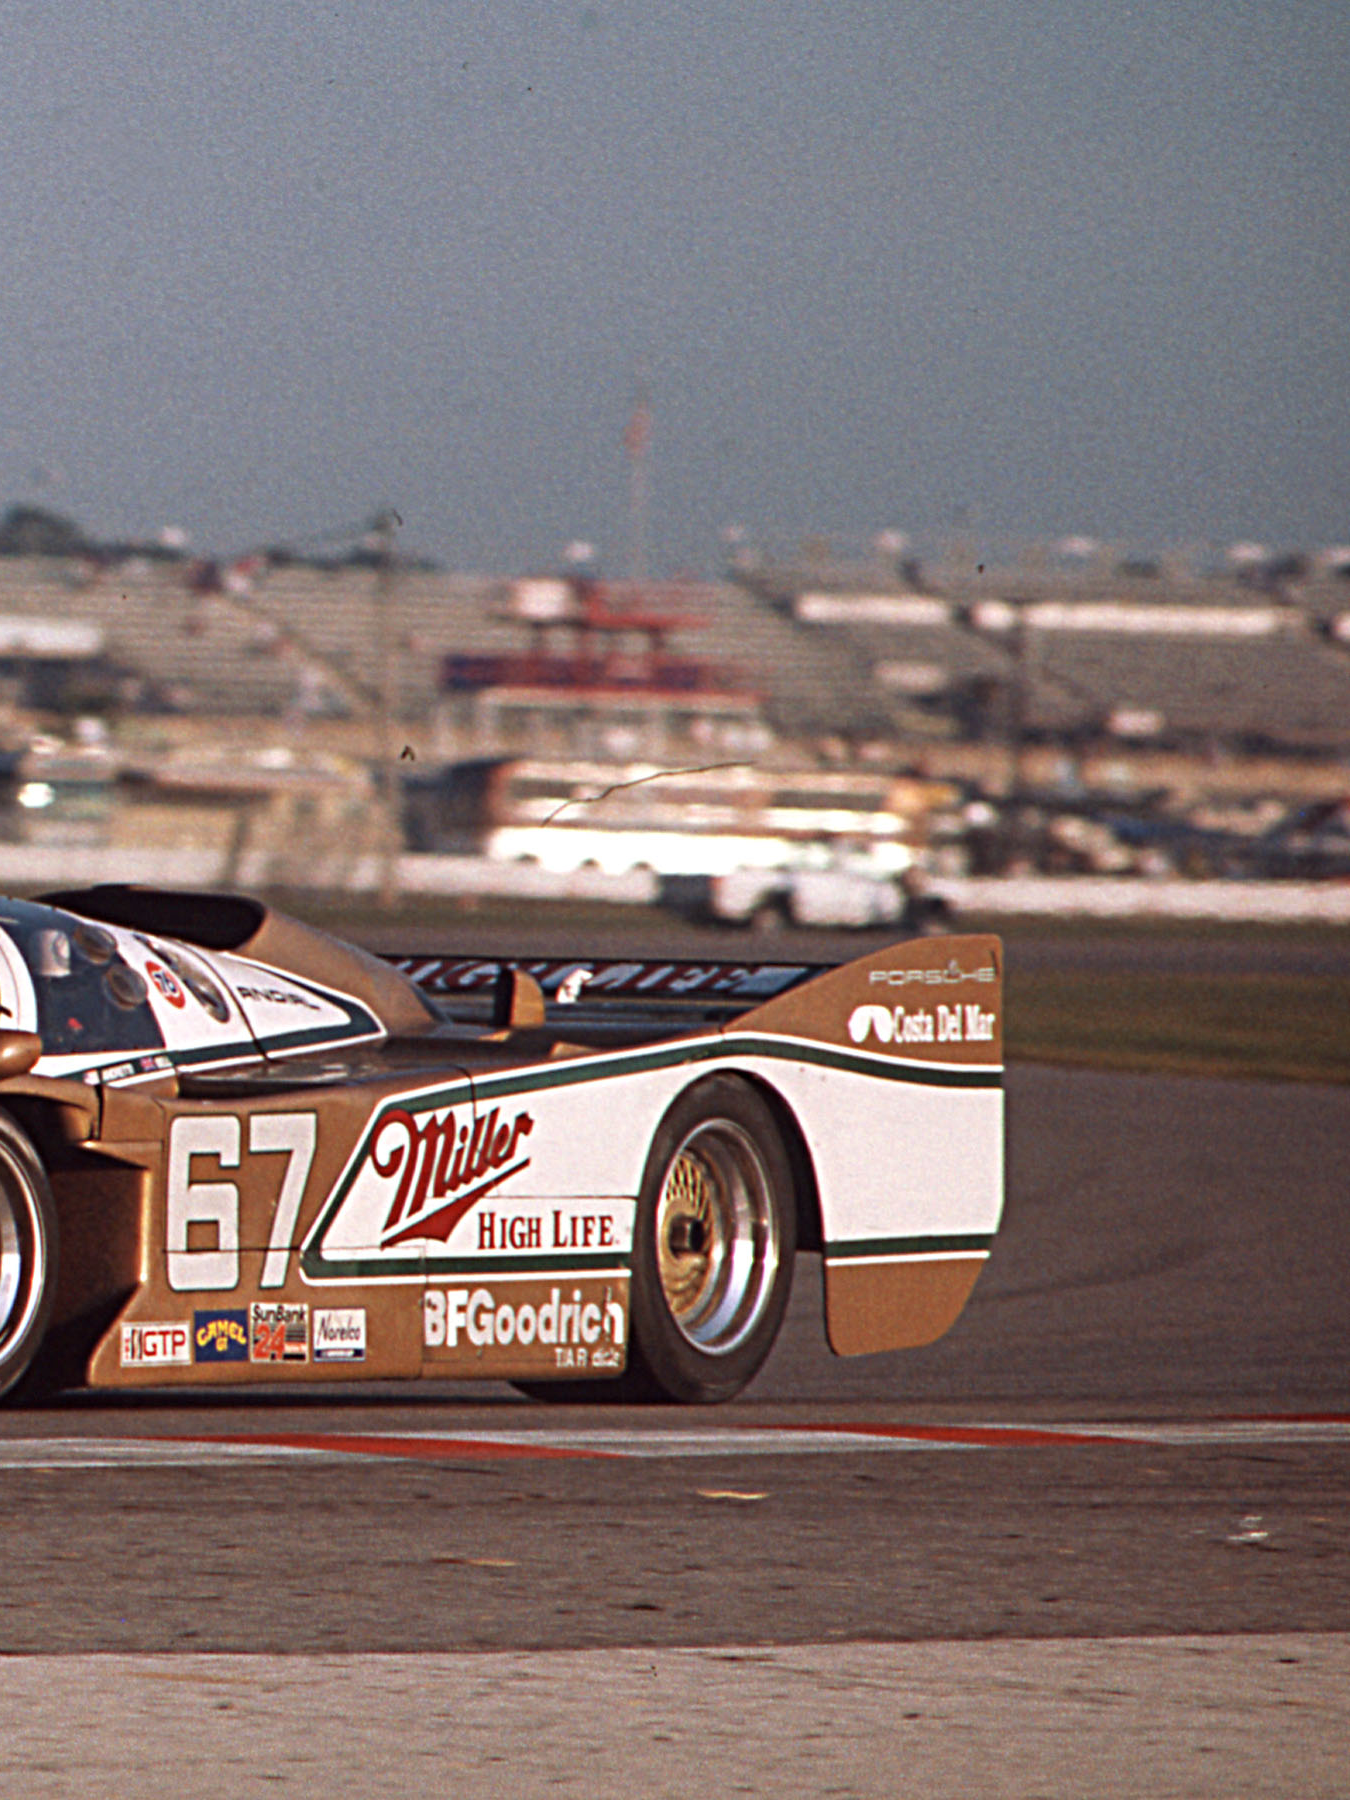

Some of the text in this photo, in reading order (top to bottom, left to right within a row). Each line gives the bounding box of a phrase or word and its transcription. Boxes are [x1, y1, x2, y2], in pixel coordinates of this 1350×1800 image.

[154, 970, 180, 995] 76
[869, 959, 996, 986] PORSCHE
[894, 1003, 996, 1043] Costa Del Mar
[370, 1107, 534, 1232] Miller
[166, 1109, 318, 1292] 67
[477, 1209, 614, 1250] HIGH LIFE
[252, 1303, 306, 1322] SunBank
[317, 1312, 361, 1346] Norelco
[423, 1287, 625, 1348] BFGoodrich
[143, 1330, 187, 1357] GTP
[197, 1319, 247, 1346] CAMEL
[253, 1323, 287, 1361] 24
